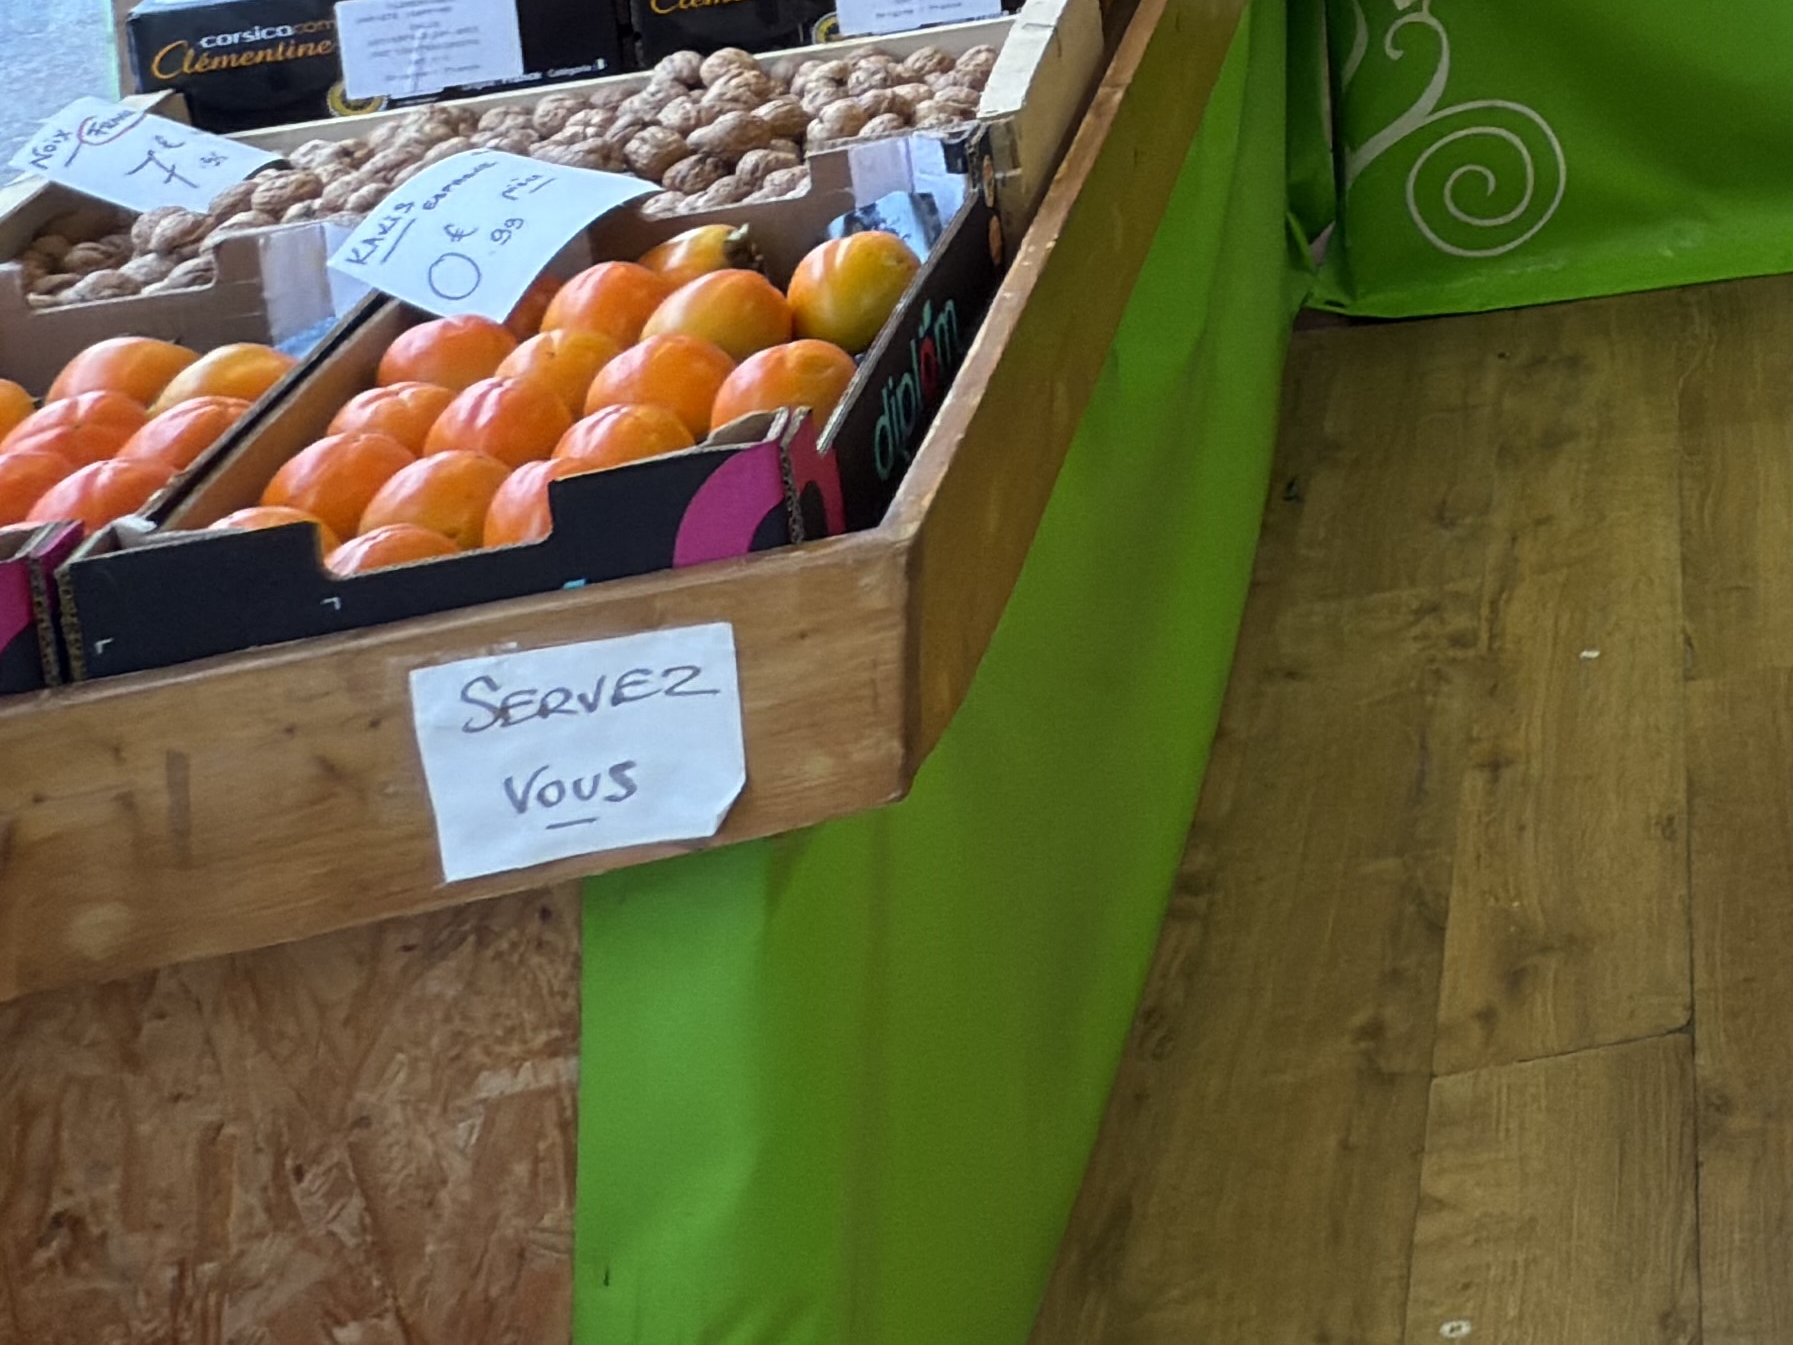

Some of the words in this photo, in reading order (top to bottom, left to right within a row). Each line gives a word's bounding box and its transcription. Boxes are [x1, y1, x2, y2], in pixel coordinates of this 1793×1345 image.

[151, 38, 337, 81] Clémentine
[29, 128, 73, 170] NOIX
[459, 663, 721, 735] SERVEZ
[503, 760, 641, 818] VOUS
